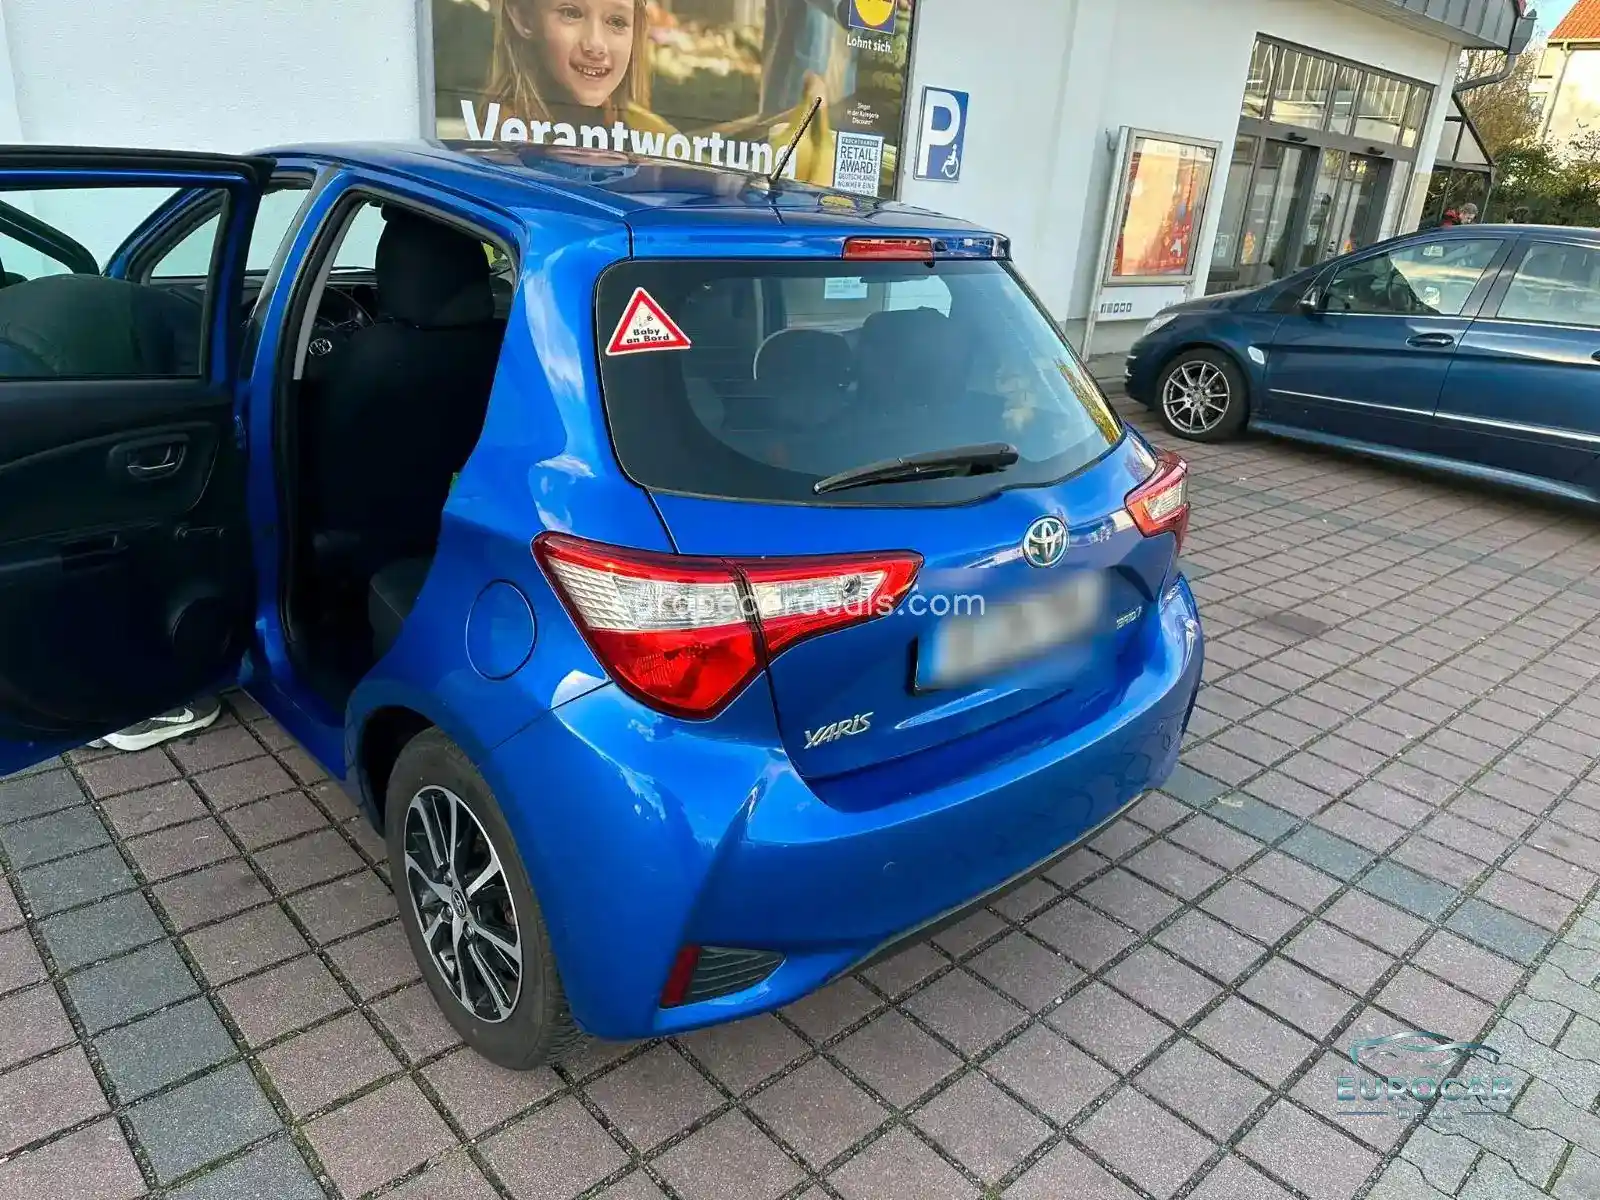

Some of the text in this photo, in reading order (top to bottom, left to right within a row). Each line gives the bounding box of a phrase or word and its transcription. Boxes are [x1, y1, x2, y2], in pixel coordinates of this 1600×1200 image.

[847, 34, 893, 54] Lohnt sich.
[917, 90, 961, 176] P
[840, 146, 873, 161] RETAIL
[839, 159, 873, 174] AWARD
[633, 327, 660, 336] Baby
[643, 334, 670, 342] Bord
[803, 711, 875, 750] YARIS
